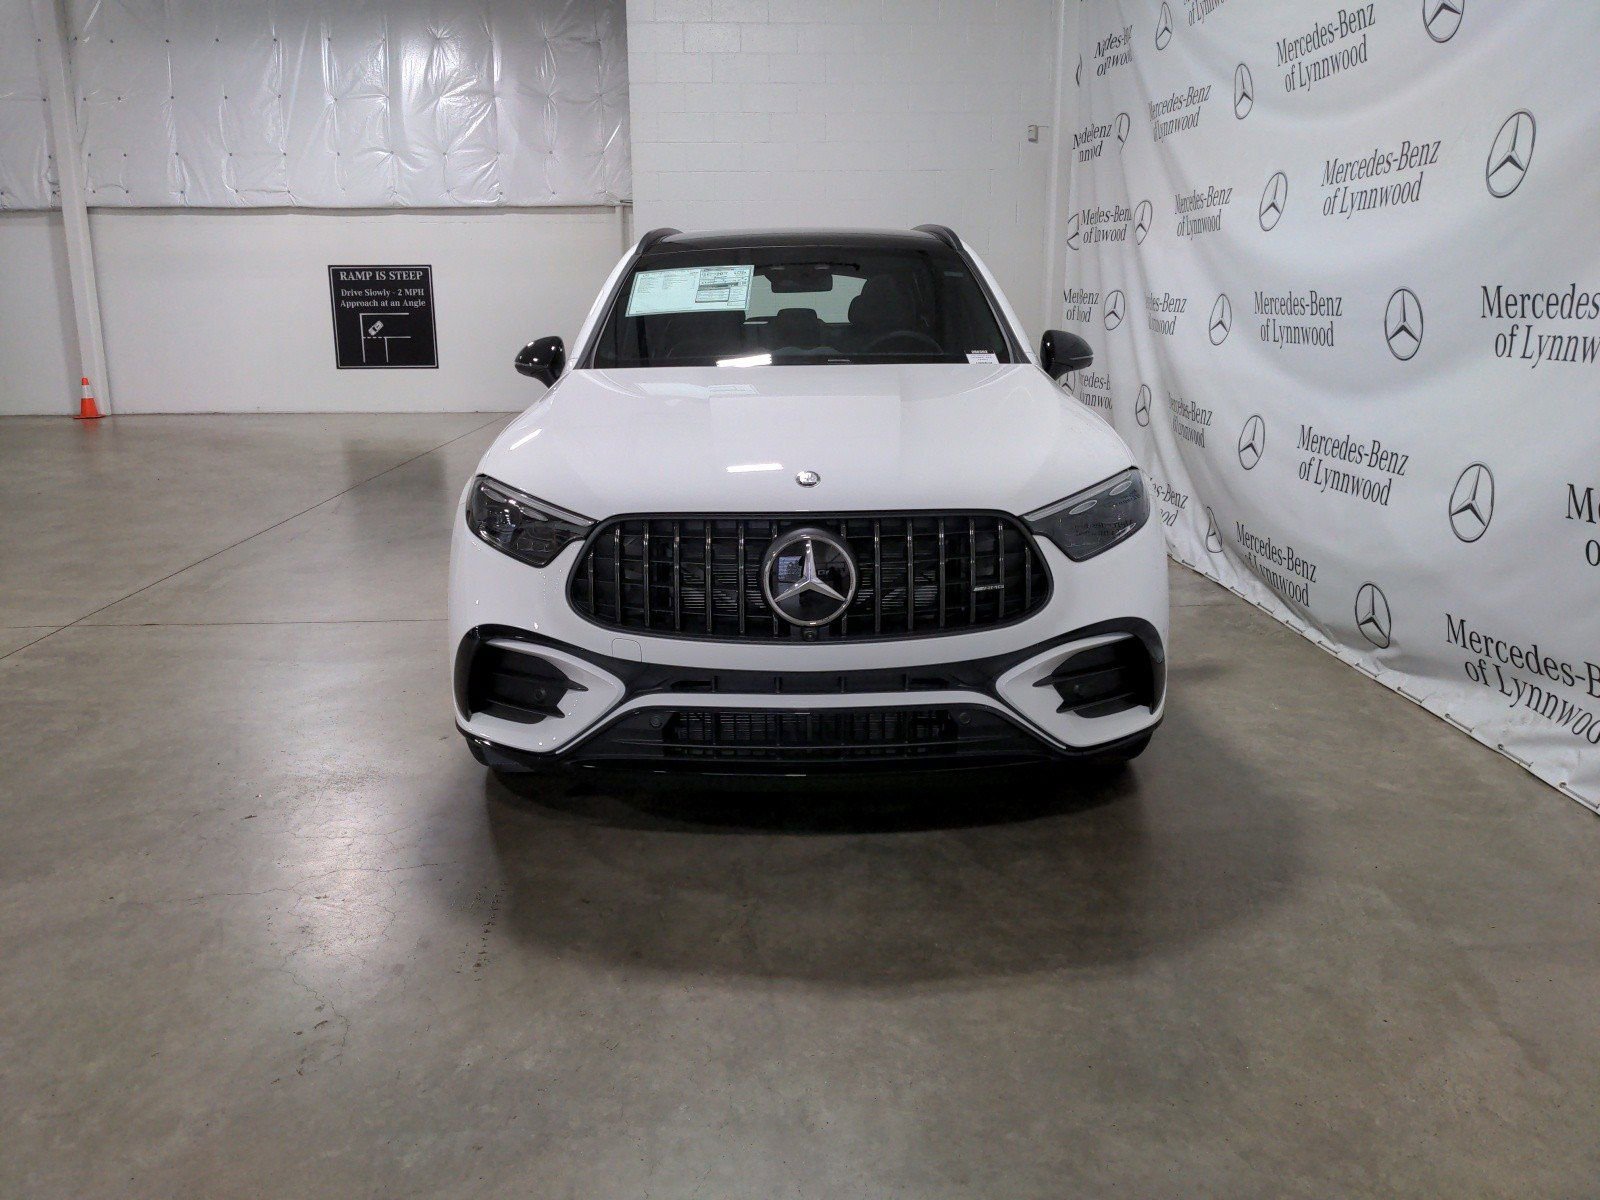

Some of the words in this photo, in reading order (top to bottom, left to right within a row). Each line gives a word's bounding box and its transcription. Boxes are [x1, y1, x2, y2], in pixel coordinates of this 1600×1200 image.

[1276, 4, 1376, 66] Mercedes-Benz
[1285, 64, 1297, 93] of
[1298, 34, 1368, 92] Lynnwood
[1321, 140, 1441, 187] Mercedes-Benz
[1323, 185, 1340, 216] of
[1339, 172, 1424, 219] Lynnwood
[340, 271, 373, 280] RAMP
[376, 271, 386, 280] IS
[389, 270, 423, 280] STEEP
[341, 288, 363, 297] Drive
[364, 288, 391, 298] Slowly
[397, 288, 403, 296] 2
[404, 288, 425, 296] MPH
[340, 299, 379, 308] Approach
[402, 299, 426, 308] Angle
[1254, 290, 1343, 317] Mercedes-Benz
[1260, 319, 1271, 342] of
[1272, 320, 1334, 349] Lynnwood
[1494, 323, 1519, 358] of
[1297, 424, 1409, 477] Mercedes-Benz
[1298, 455, 1314, 481] of
[1314, 458, 1392, 506] Lynnwood
[1236, 521, 1317, 583] Mercedes-Benz
[1464, 658, 1491, 687] of
